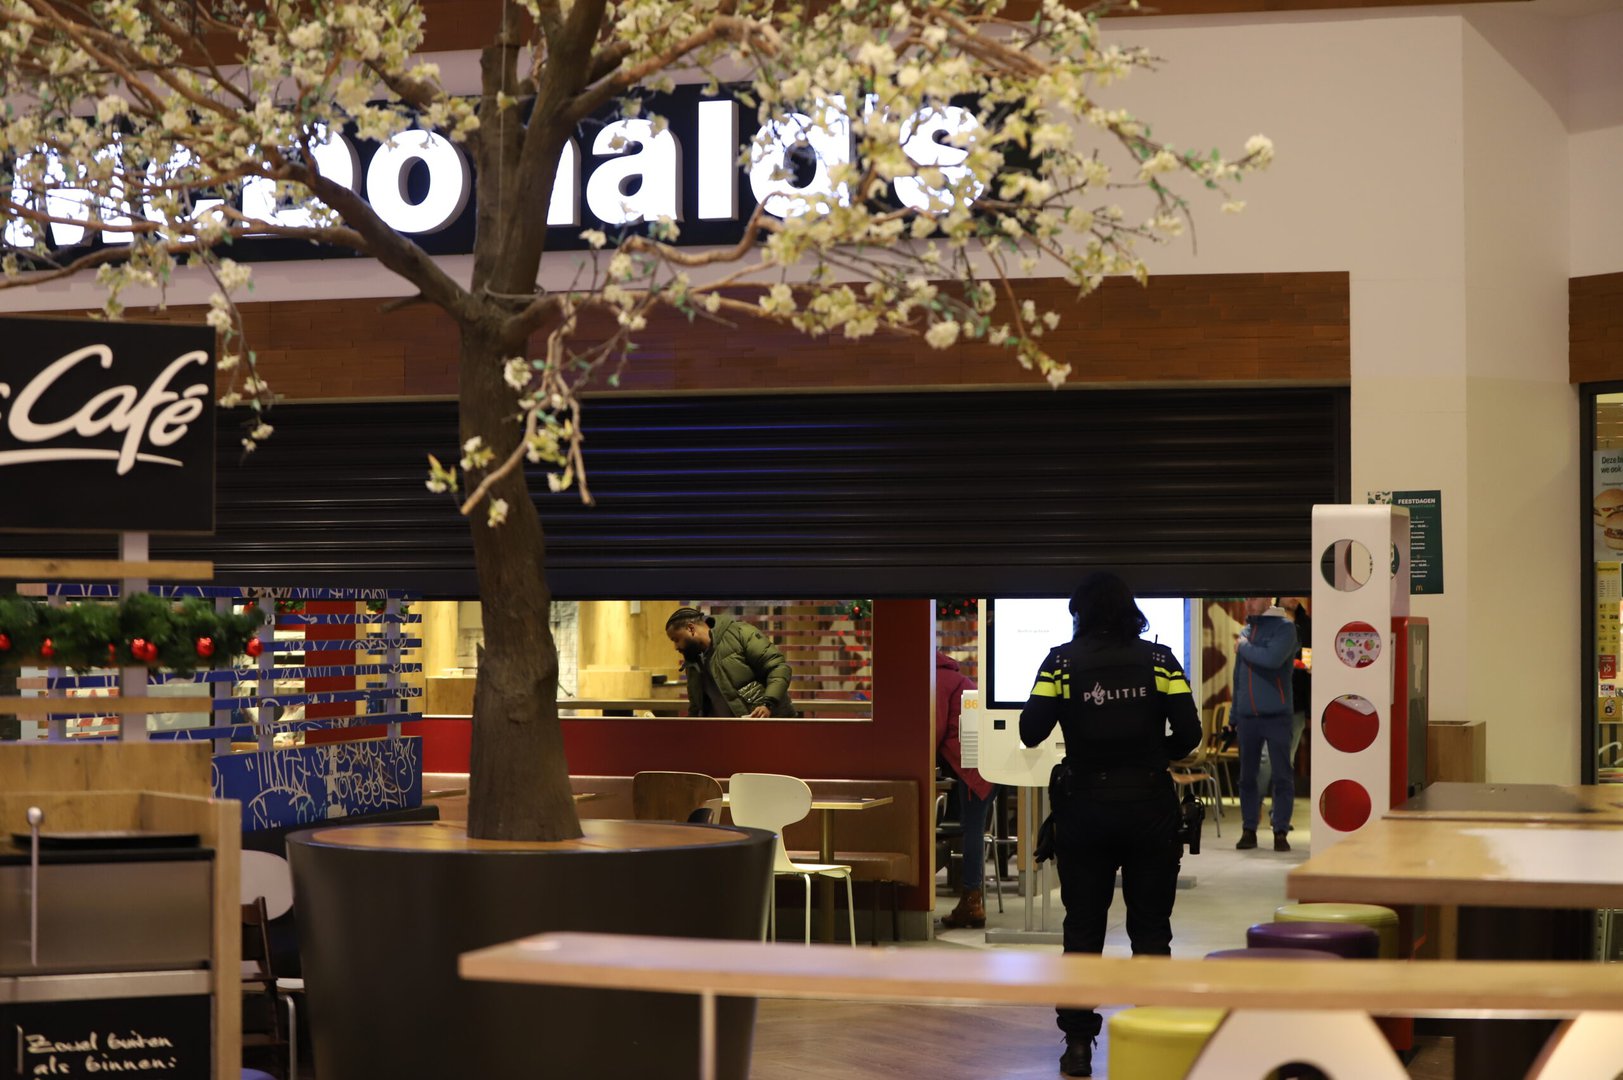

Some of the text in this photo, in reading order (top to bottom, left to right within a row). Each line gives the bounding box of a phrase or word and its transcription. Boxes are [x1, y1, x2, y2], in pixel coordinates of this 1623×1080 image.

[0, 343, 209, 476] Café
[1610, 464, 1622, 473] ook
[33, 1055, 70, 1075] als
